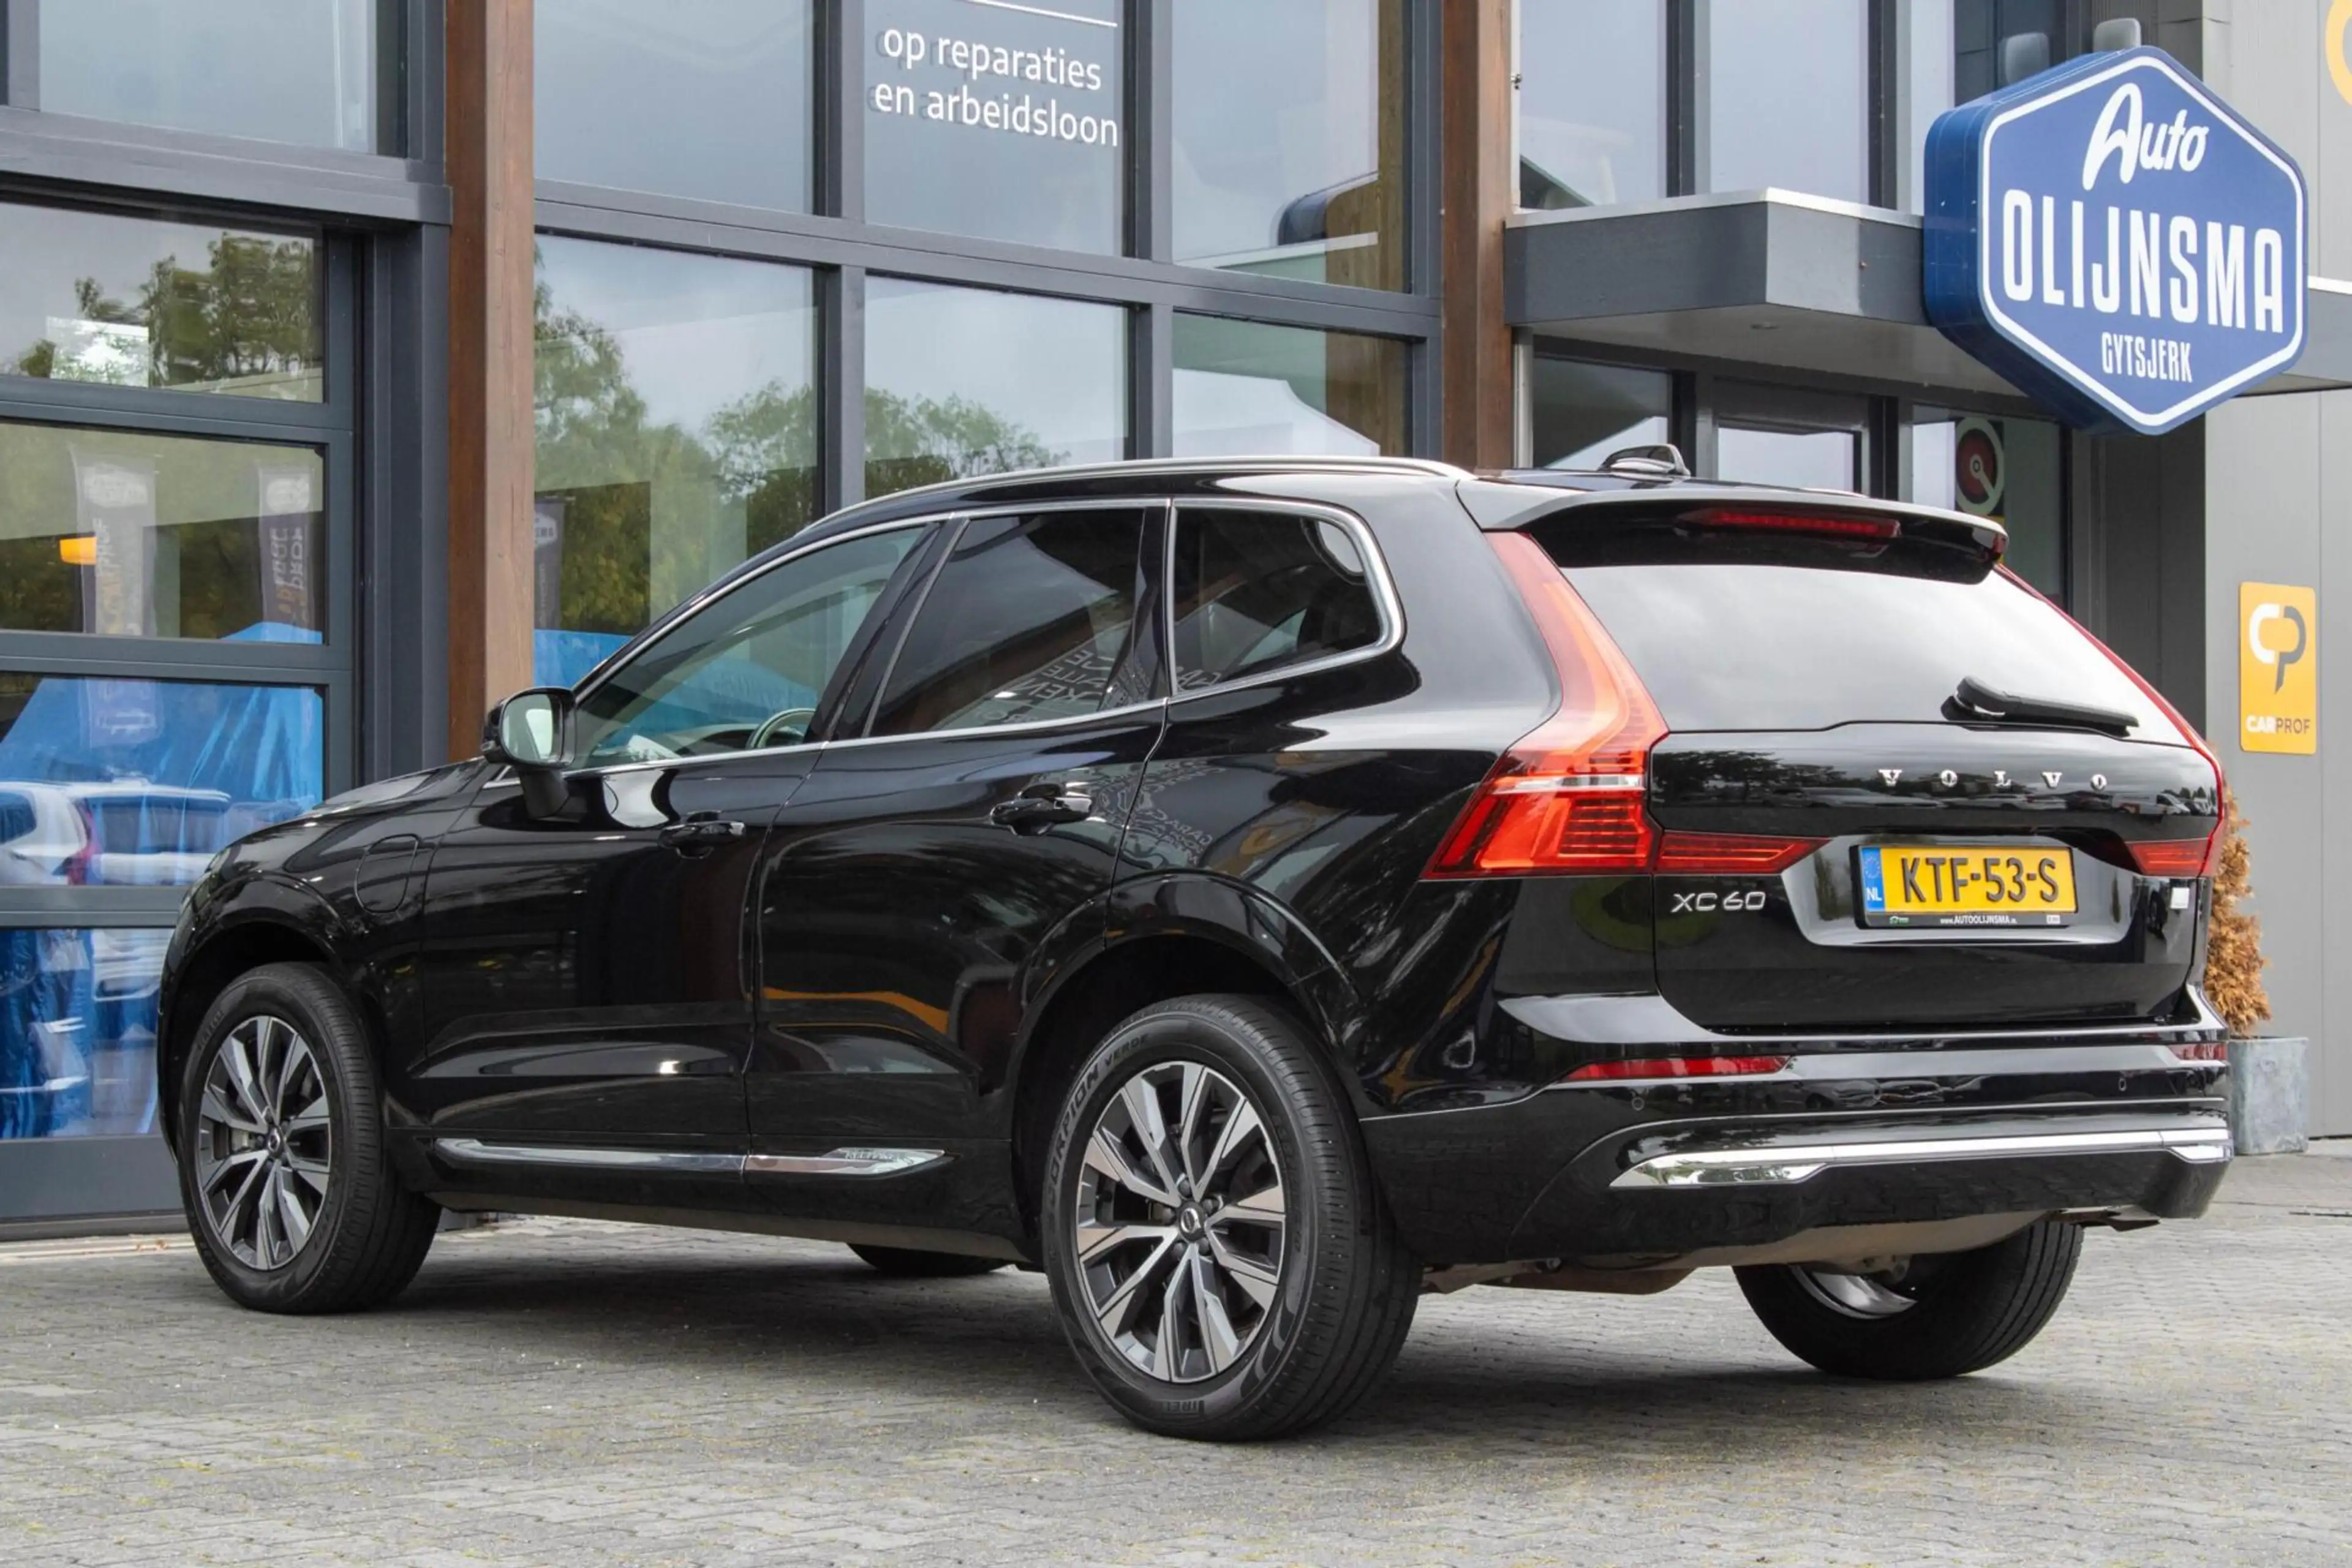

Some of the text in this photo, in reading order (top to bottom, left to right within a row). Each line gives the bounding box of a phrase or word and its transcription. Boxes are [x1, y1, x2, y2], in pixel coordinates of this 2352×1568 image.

[884, 28, 1102, 91] op reparaties
[875, 83, 1118, 146] en arbeidsloon
[2082, 82, 2209, 190] Auto
[2002, 189, 2283, 334] OLIJNSMA
[2101, 331, 2193, 383] GYTSJERK
[2246, 715, 2311, 734] CARPROF
[1878, 769, 2108, 791] VOLVO
[1670, 891, 1766, 913] XC60
[1867, 888, 1882, 901] NL
[1901, 858, 2059, 903] KTF-53-S
[1940, 915, 2018, 925] www.AUTOOLIJNSMA.
